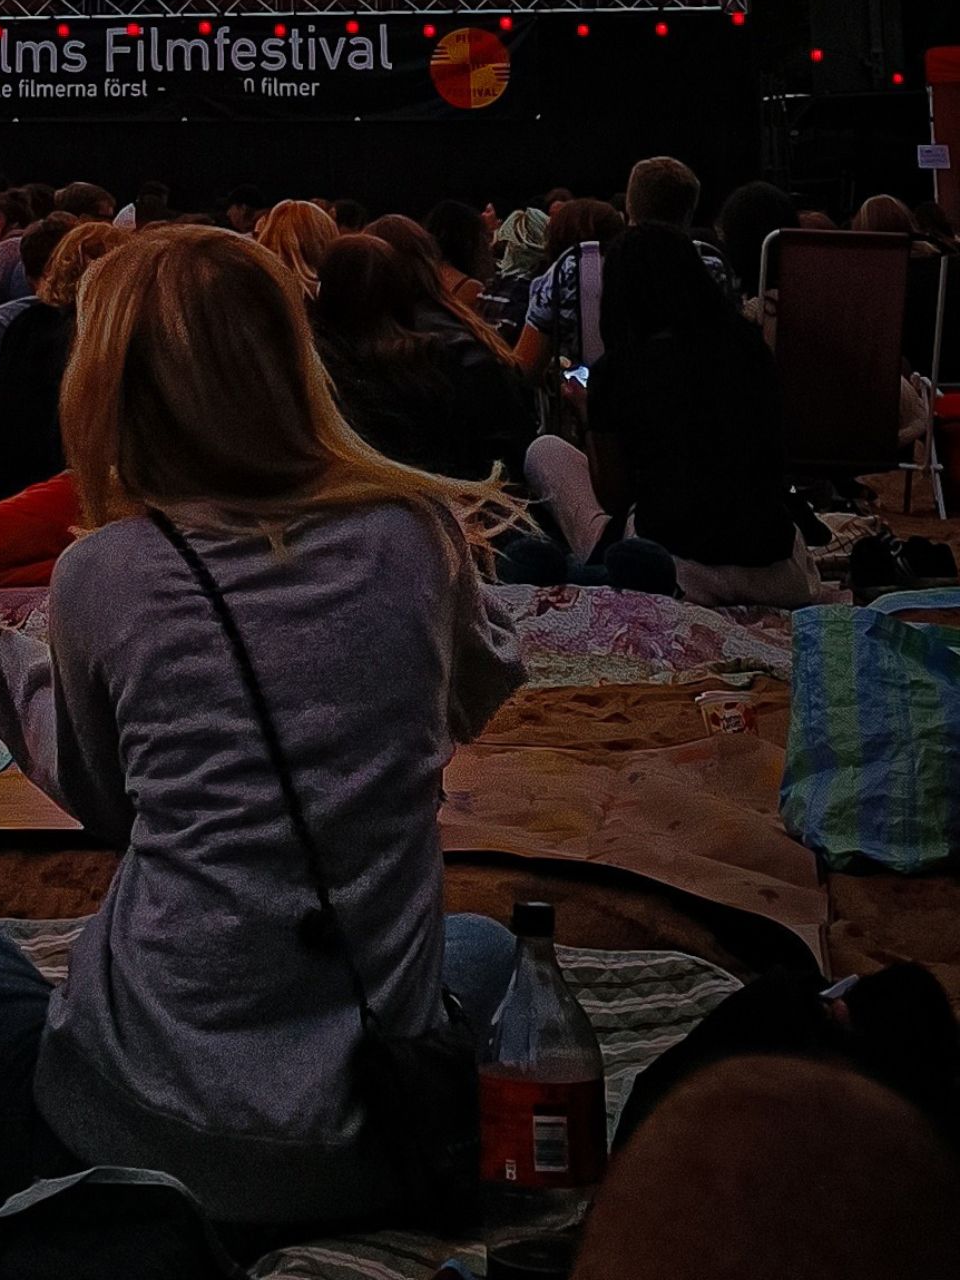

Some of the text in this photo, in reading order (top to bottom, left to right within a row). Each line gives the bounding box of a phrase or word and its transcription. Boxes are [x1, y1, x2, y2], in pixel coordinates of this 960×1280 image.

[105, 23, 393, 72] Filmfestival
[18, 79, 98, 98] filmerna
[103, 78, 148, 97] först
[261, 77, 320, 97] filmer
